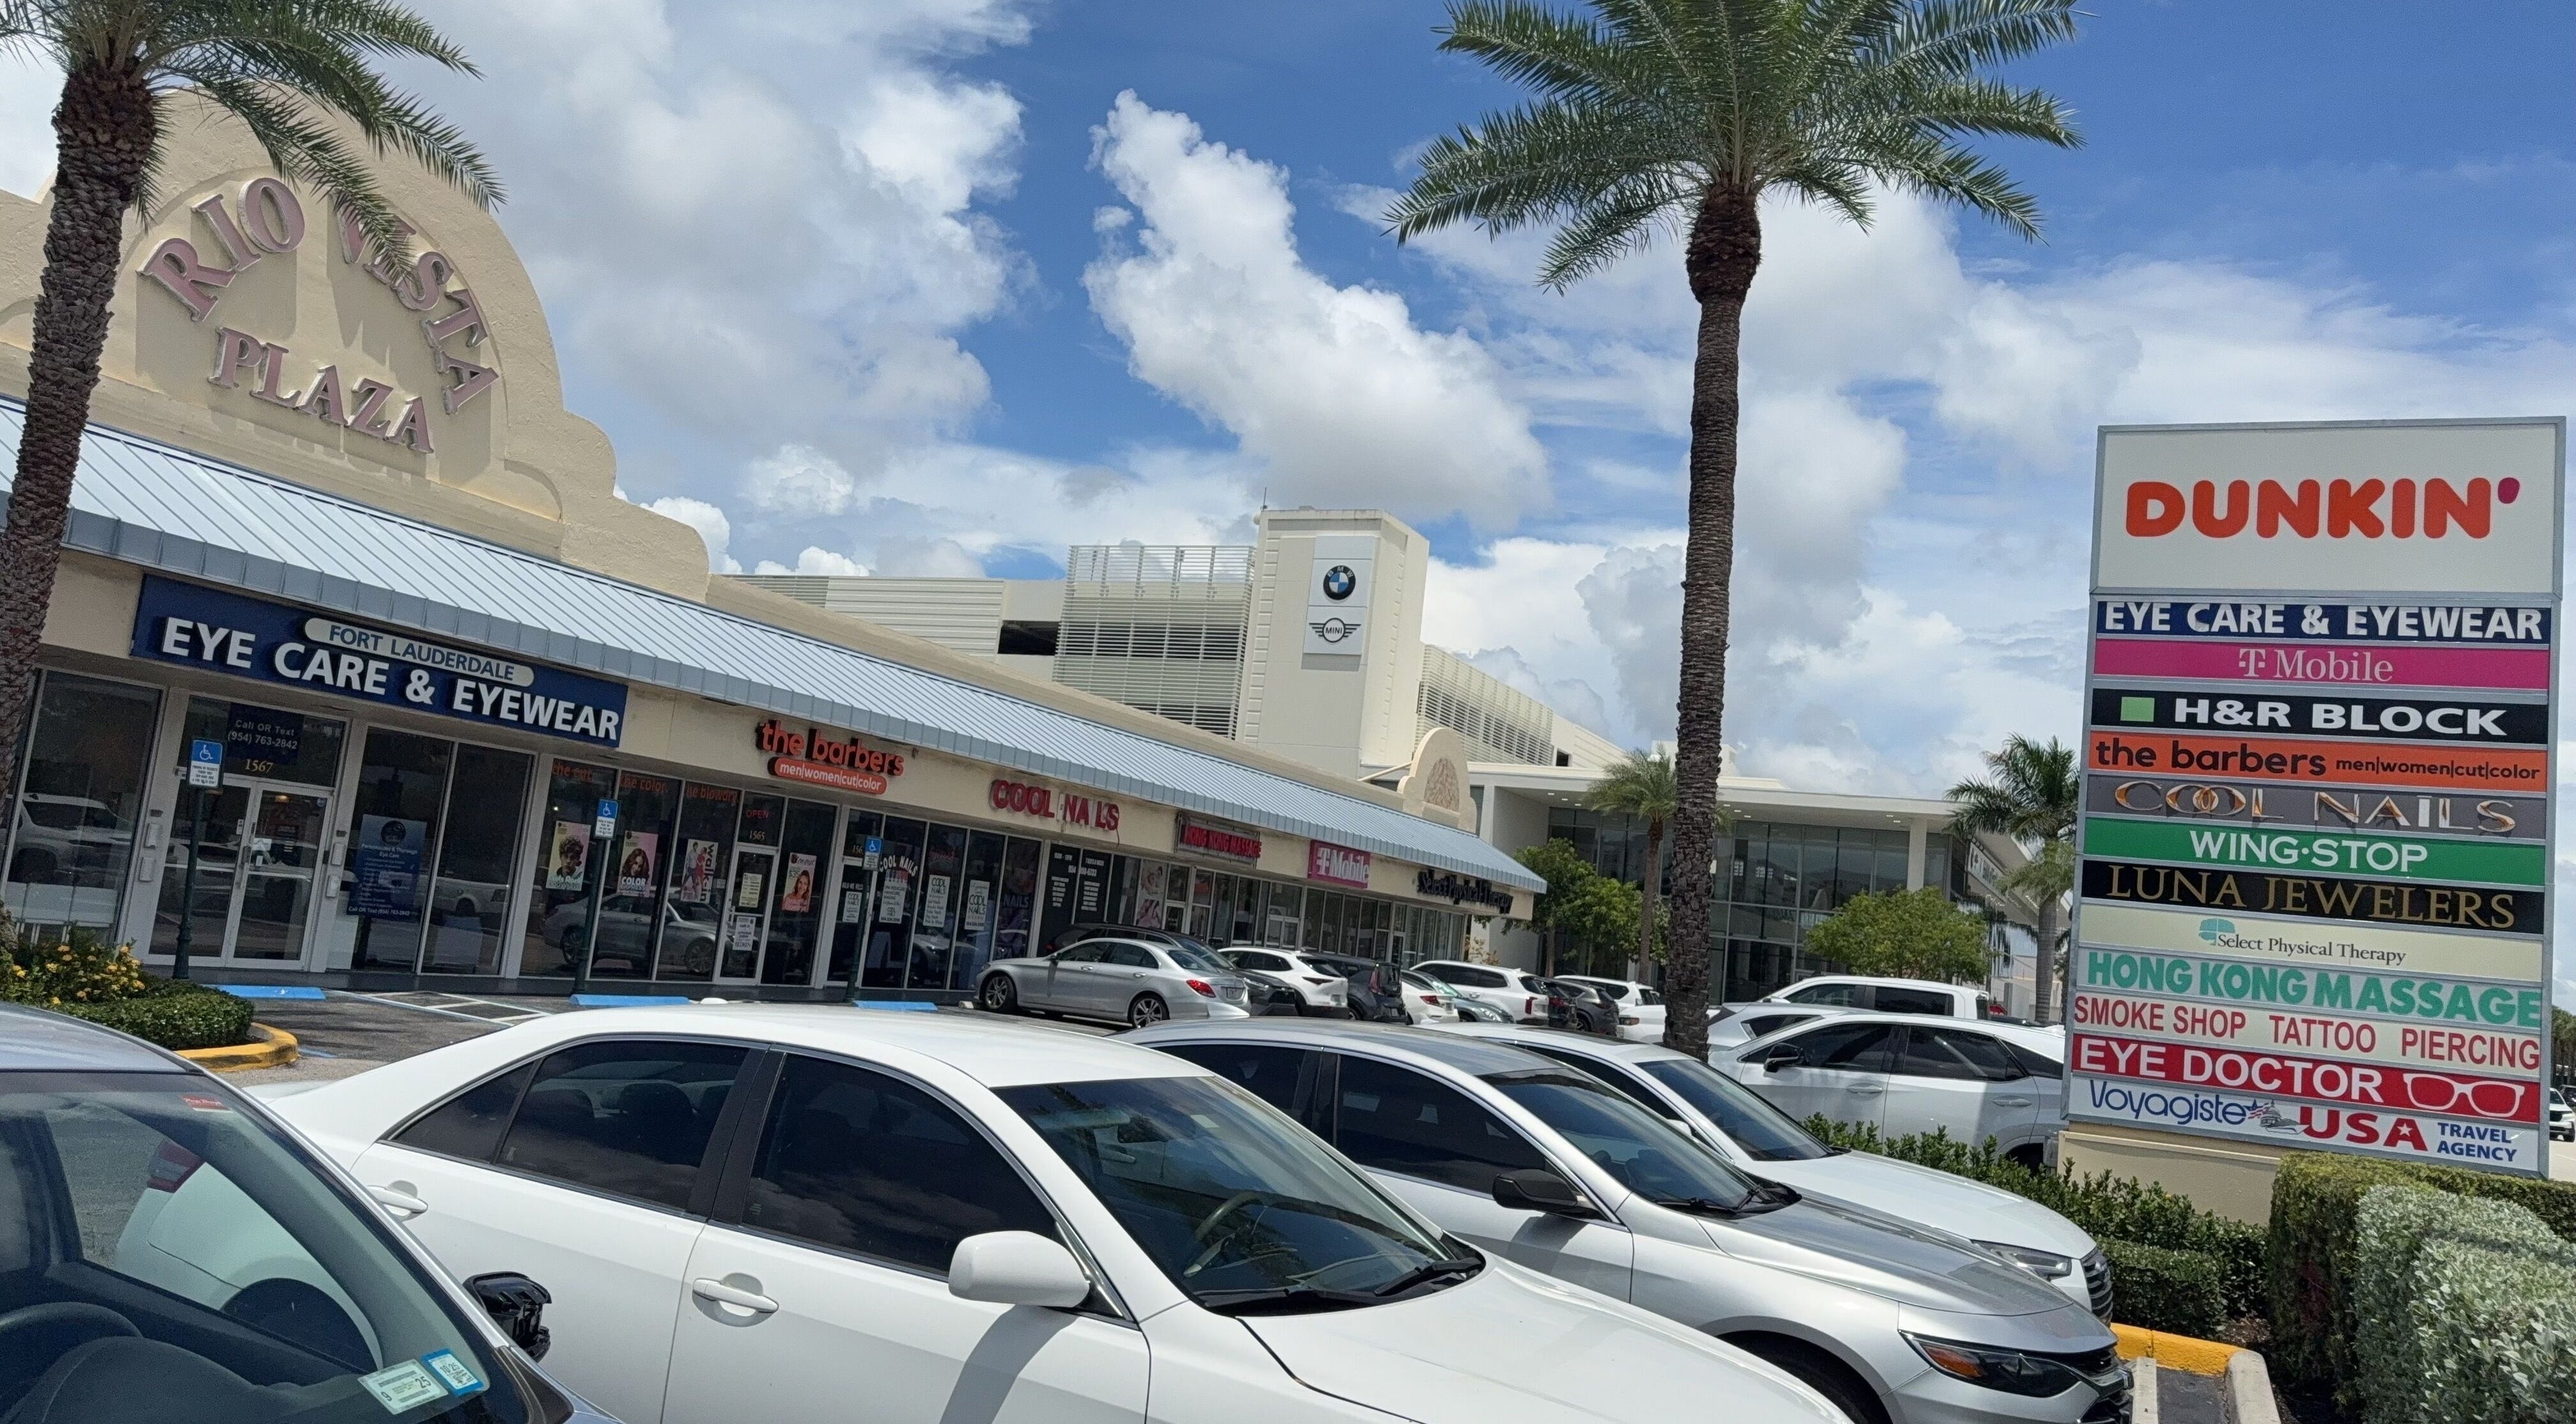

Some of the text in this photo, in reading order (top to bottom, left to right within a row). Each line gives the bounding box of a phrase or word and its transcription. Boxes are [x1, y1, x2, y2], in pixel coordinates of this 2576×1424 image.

[136, 177, 305, 321] RIO
[207, 327, 434, 453] PLAZA
[2125, 477, 2520, 539] DUNKIN'
[1327, 565, 1354, 578] BMW
[2106, 602, 2542, 639] EYE CARE & EYEWEAR
[329, 624, 515, 681] FORT LAUDERDALE
[2274, 649, 2393, 682] Mobile
[162, 616, 620, 741] EYE CARE & EYEWEAR
[235, 720, 294, 736] Call OR Text
[2175, 698, 2508, 736] H&R BLOCK
[227, 730, 298, 750] (954) 763-2842
[762, 720, 905, 777] the barbers
[2096, 738, 2157, 767] the
[2171, 740, 2326, 776] barbers
[245, 759, 274, 773] 1567
[746, 810, 769, 818] OPEN
[993, 779, 1055, 818] COOL
[2114, 780, 2516, 832] COOL NAILS
[1185, 825, 1262, 859] HONG KONG MASSAGE
[621, 876, 646, 885] COLOR
[700, 843, 714, 901] walk-in
[879, 855, 897, 872] COOL
[899, 855, 918, 877] NAILS
[931, 877, 947, 887] COOL
[1329, 849, 1370, 883] Mobile
[969, 894, 987, 906] COOL
[1004, 895, 1030, 906] NAILS
[2106, 865, 2515, 928] LUNA JEWELERS
[2218, 934, 2407, 966] Select Physical Therapy
[2088, 952, 2542, 1028] HONG KONG MASSAGE
[2074, 995, 2540, 1071] SMOKE SHOP TATTOO PIERCING
[2080, 1038, 2384, 1103] EYE DOCTOR
[2090, 1079, 2428, 1152] Voyagiste USA
[2437, 1122, 2512, 1144] TRAVEL
[2436, 1140, 2518, 1162] AGENCY
[381, 1391, 392, 1402] 9
[415, 1376, 432, 1389] 25
